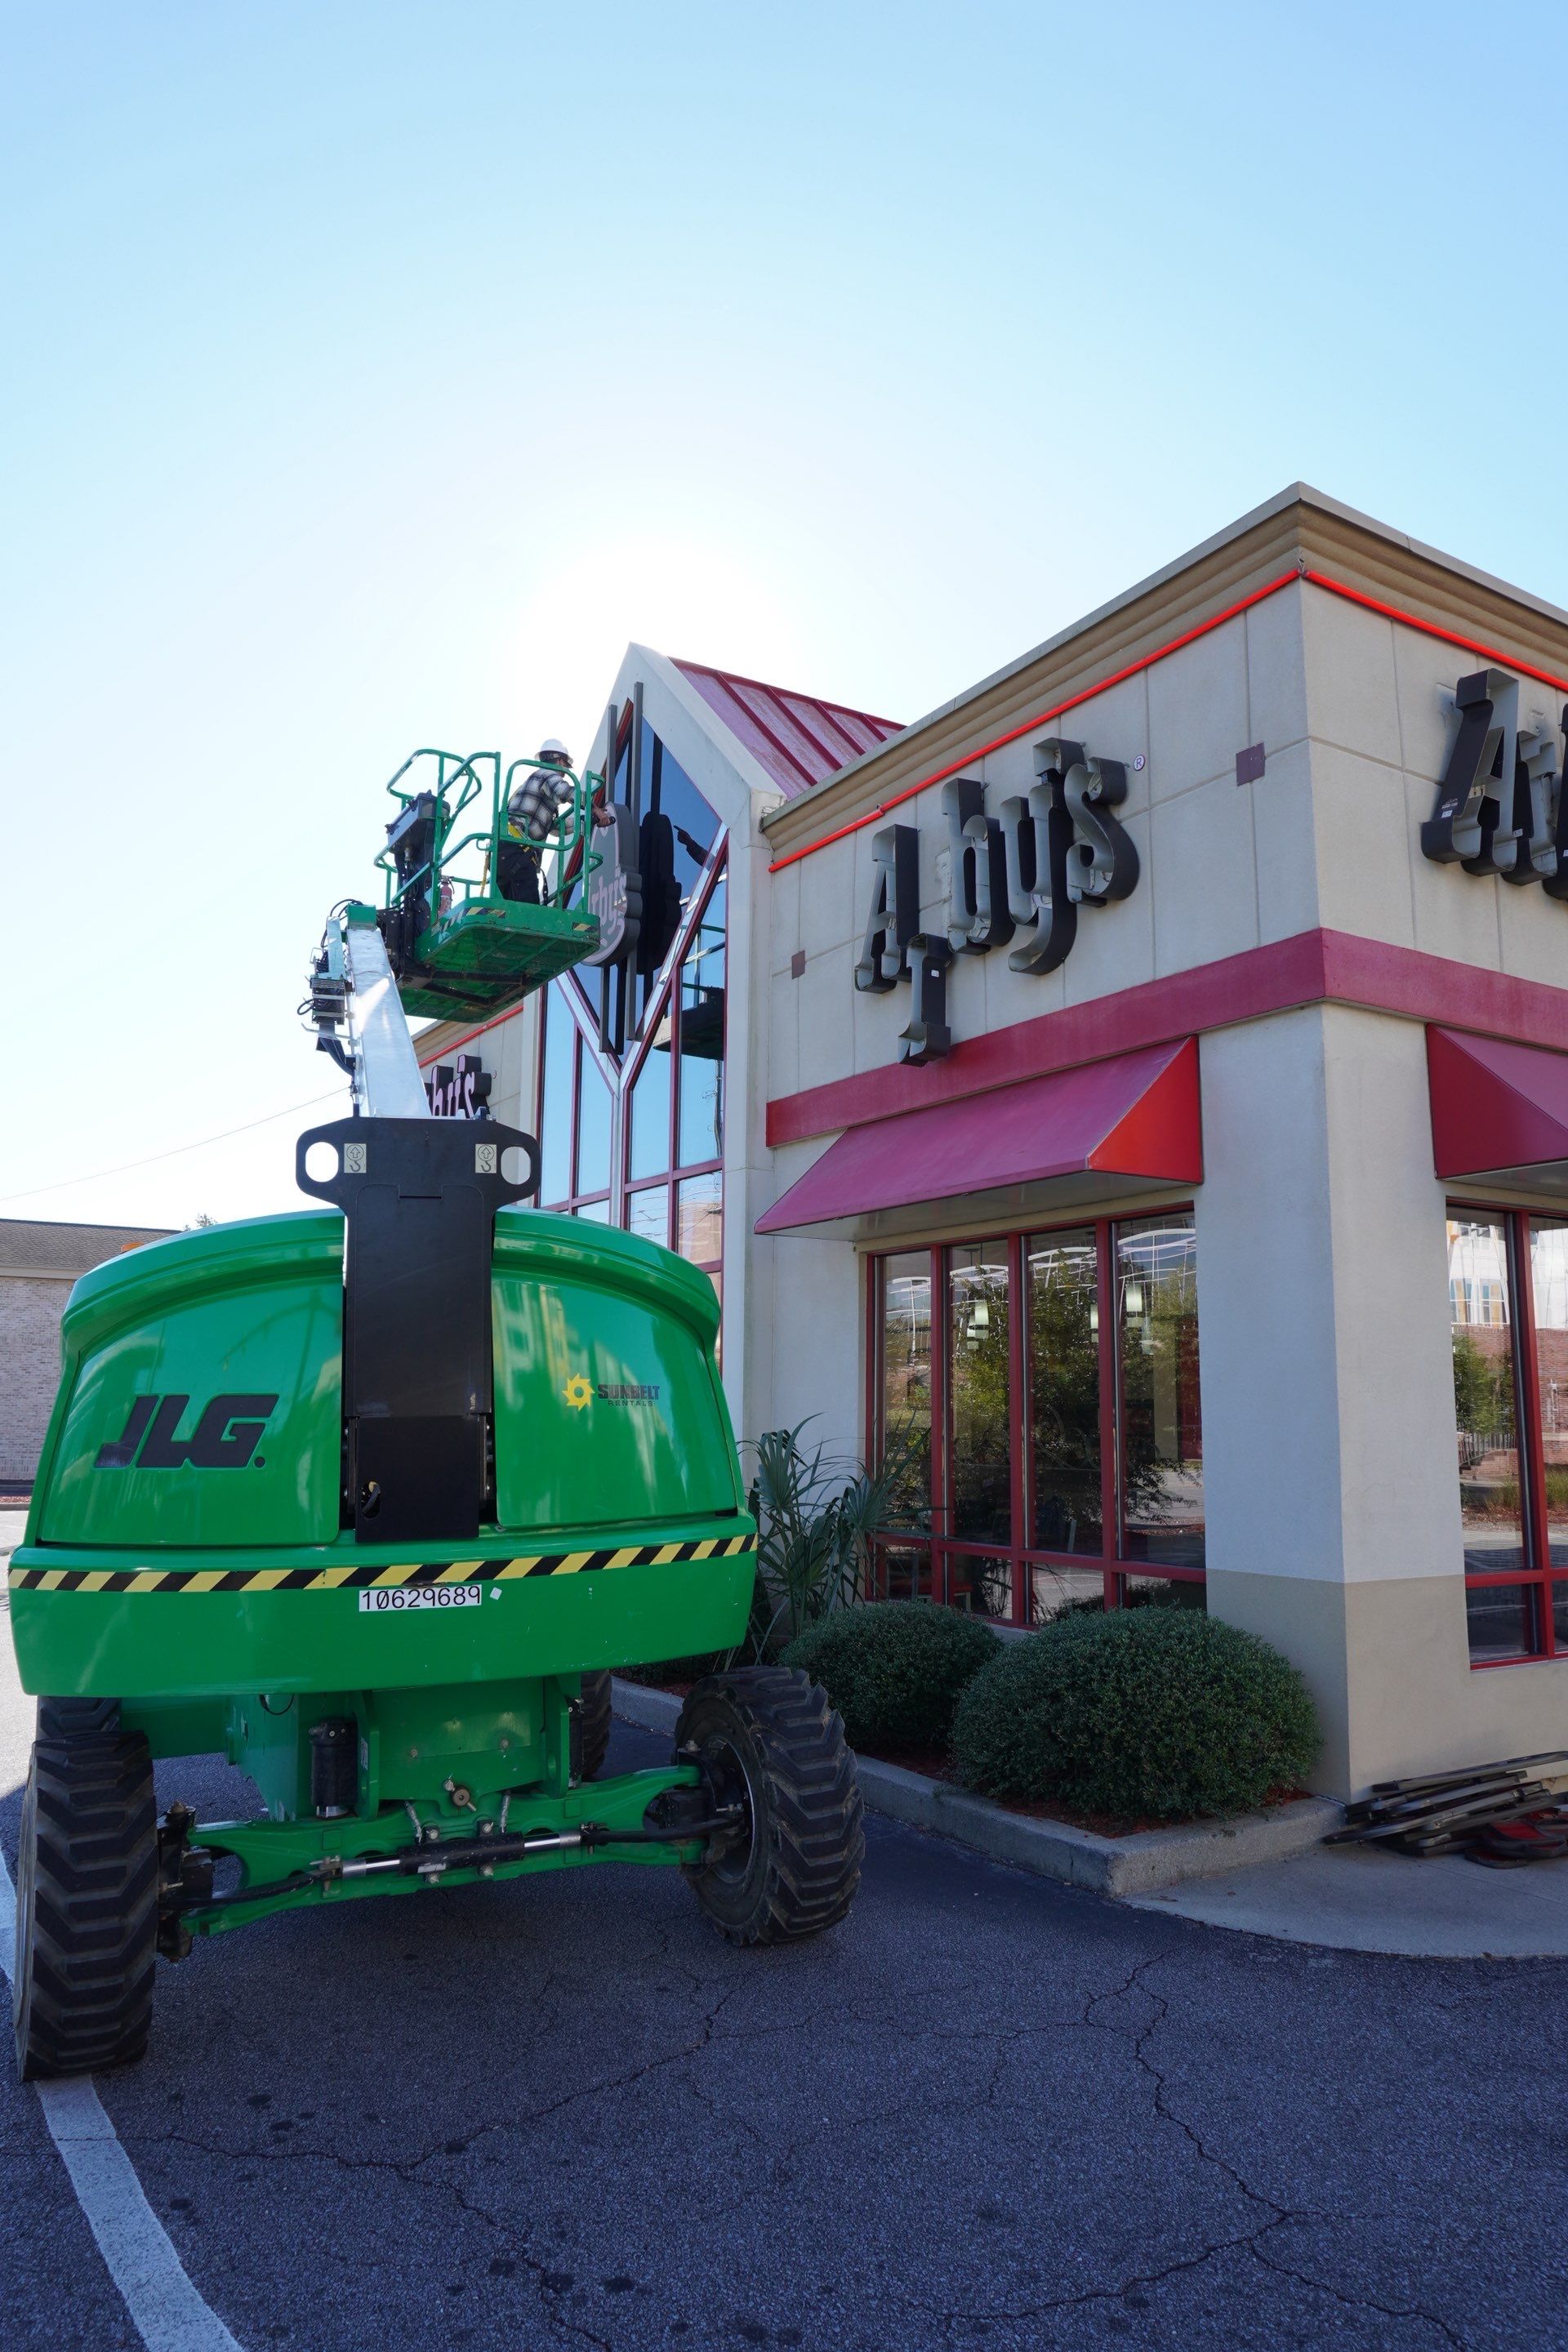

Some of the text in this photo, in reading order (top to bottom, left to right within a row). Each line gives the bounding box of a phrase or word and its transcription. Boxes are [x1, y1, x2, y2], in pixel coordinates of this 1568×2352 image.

[1421, 667, 1568, 901] Ar
[597, 1384, 660, 1400] SUNBELT
[362, 1585, 480, 1610] 10629689
